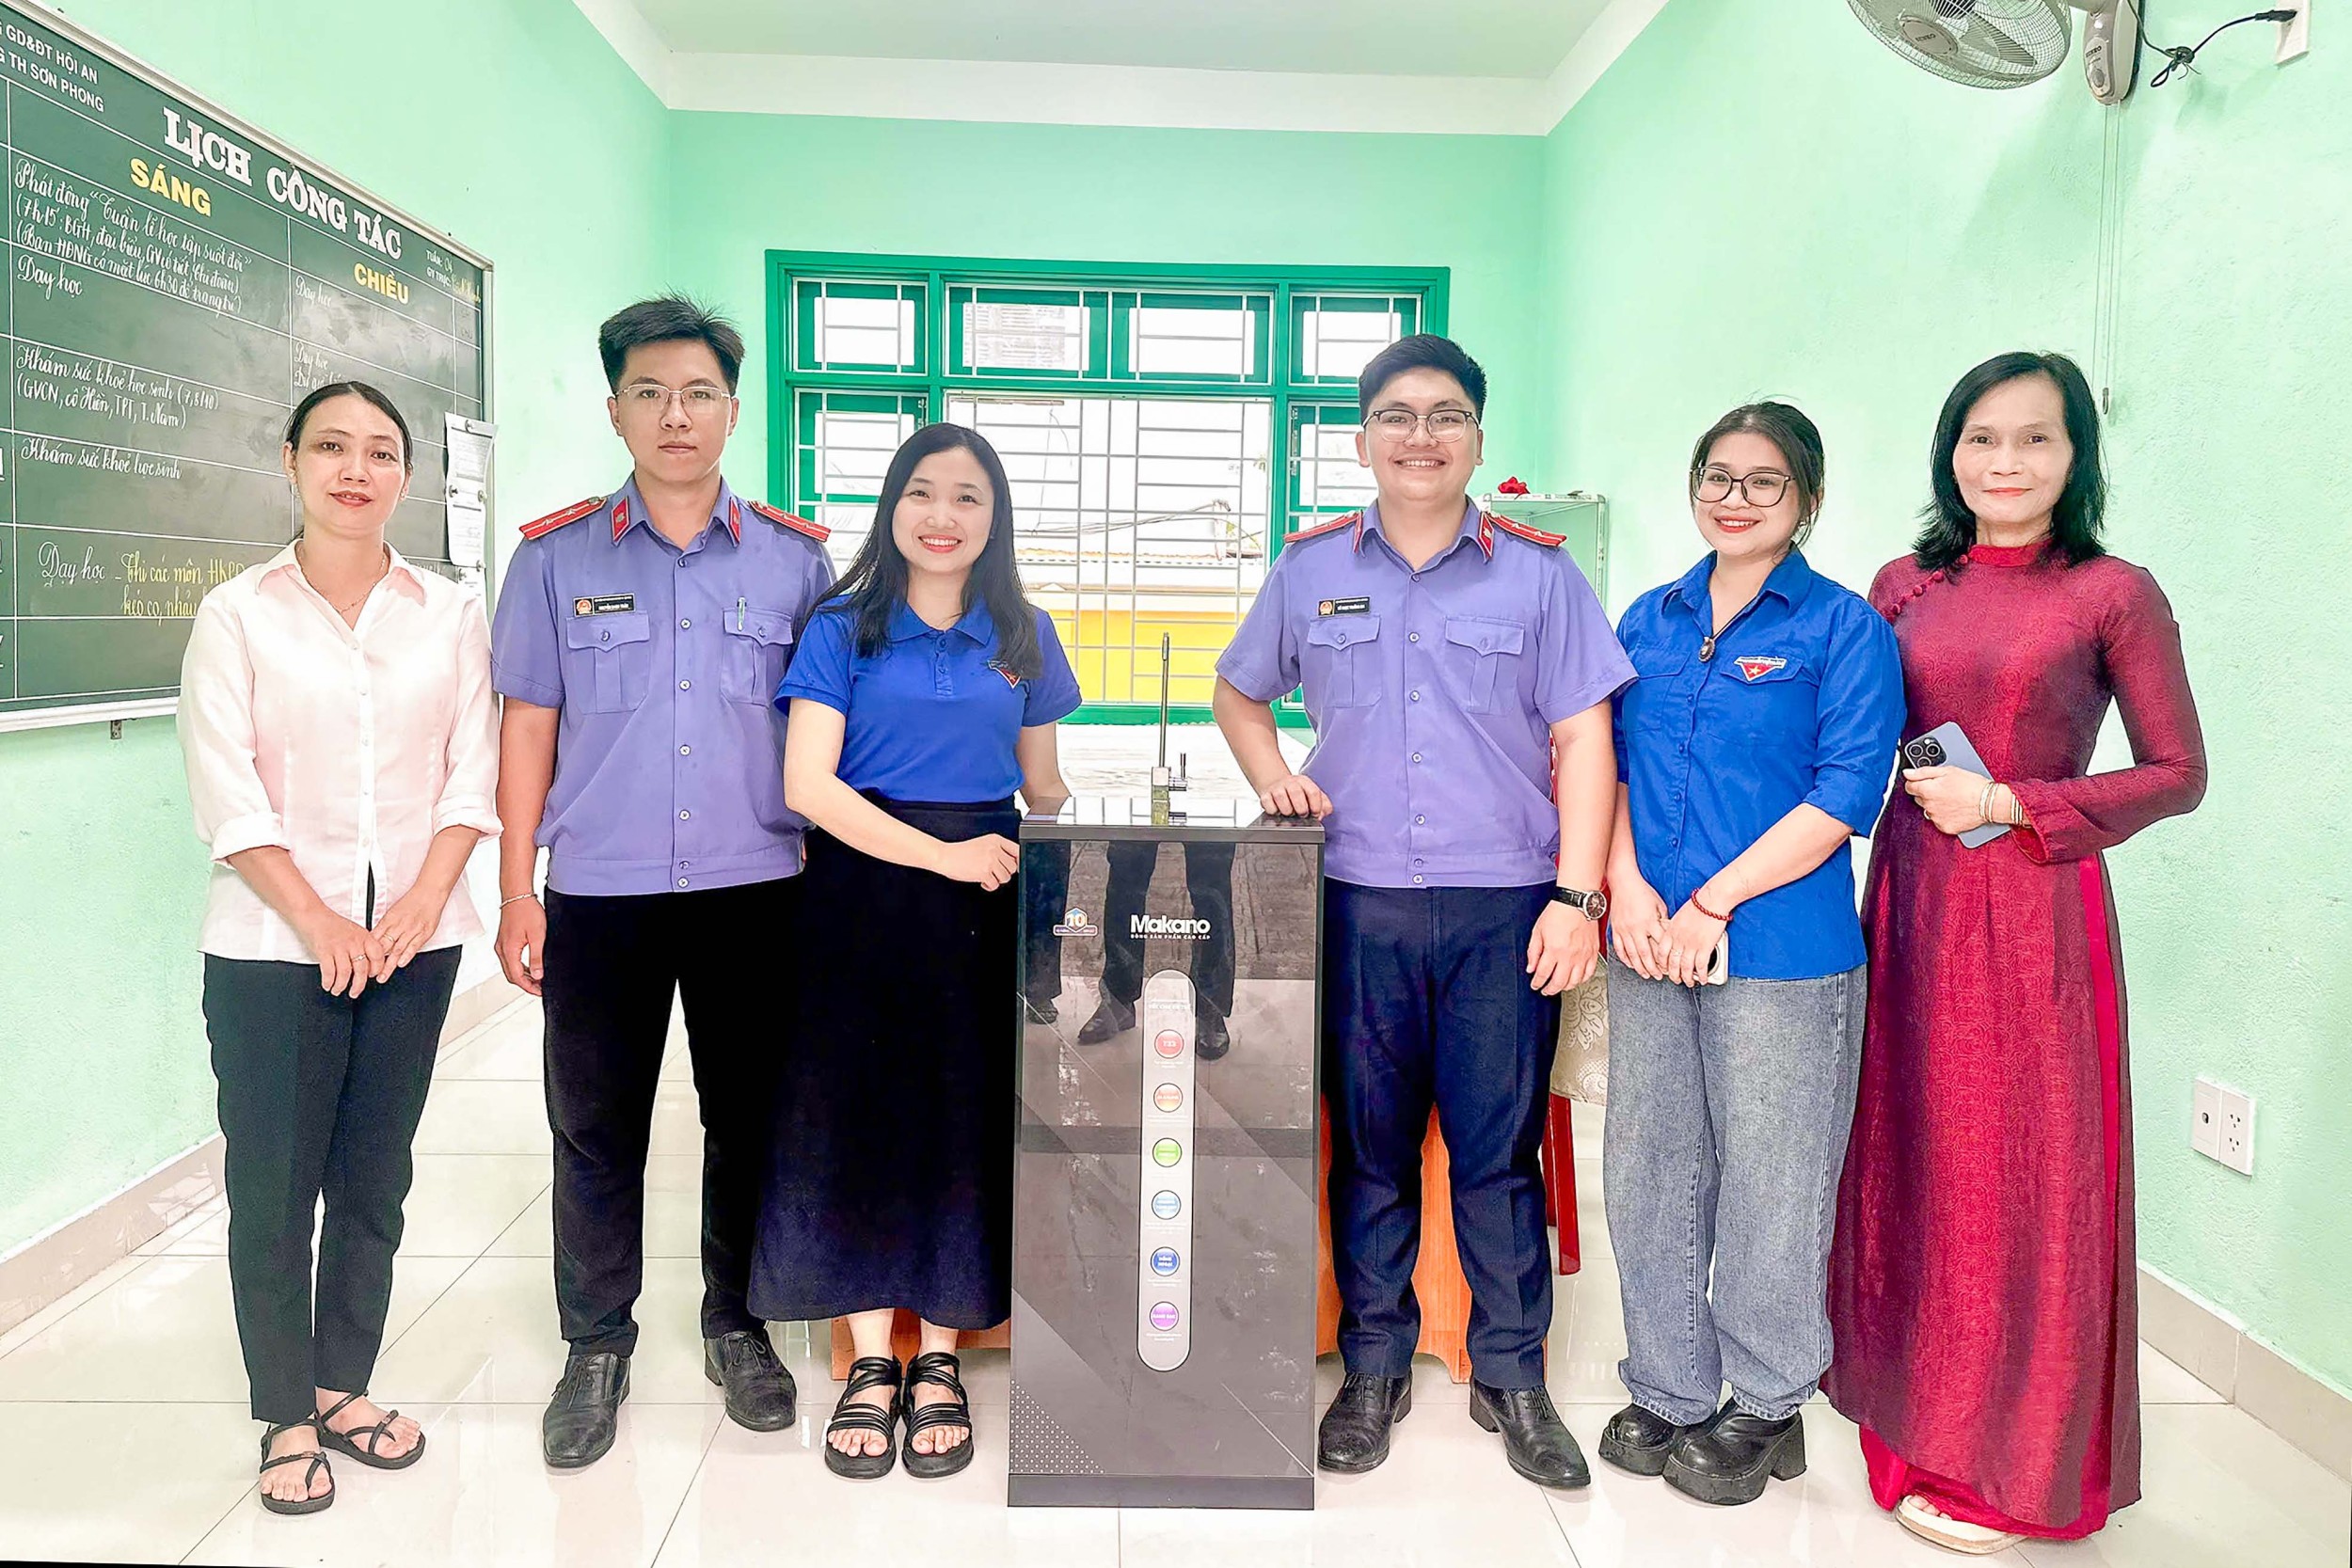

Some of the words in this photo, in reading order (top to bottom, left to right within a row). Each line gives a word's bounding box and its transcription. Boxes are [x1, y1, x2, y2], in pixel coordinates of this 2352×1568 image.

[6, 24, 53, 60] GD&ĐT
[56, 49, 78, 75] HỘI
[81, 64, 98, 85] AN
[8, 51, 27, 74] TH
[30, 63, 57, 89] SƠN
[60, 78, 104, 113] PHONG
[129, 157, 212, 218] SÁNG
[163, 105, 253, 187] LỊCH
[266, 166, 348, 233] CÔNG
[353, 207, 402, 260] TÁC
[17, 254, 56, 300] Dạy
[57, 261, 84, 298] học
[353, 262, 409, 305] CHIỀU
[16, 344, 72, 378] Khám
[72, 358, 92, 383] sức
[20, 437, 76, 466] Khám
[76, 446, 102, 468] sức
[38, 541, 78, 588] Dạy
[80, 546, 106, 585] học
[150, 554, 171, 583] các
[173, 557, 204, 585] môn
[1130, 914, 1211, 934] Makano
